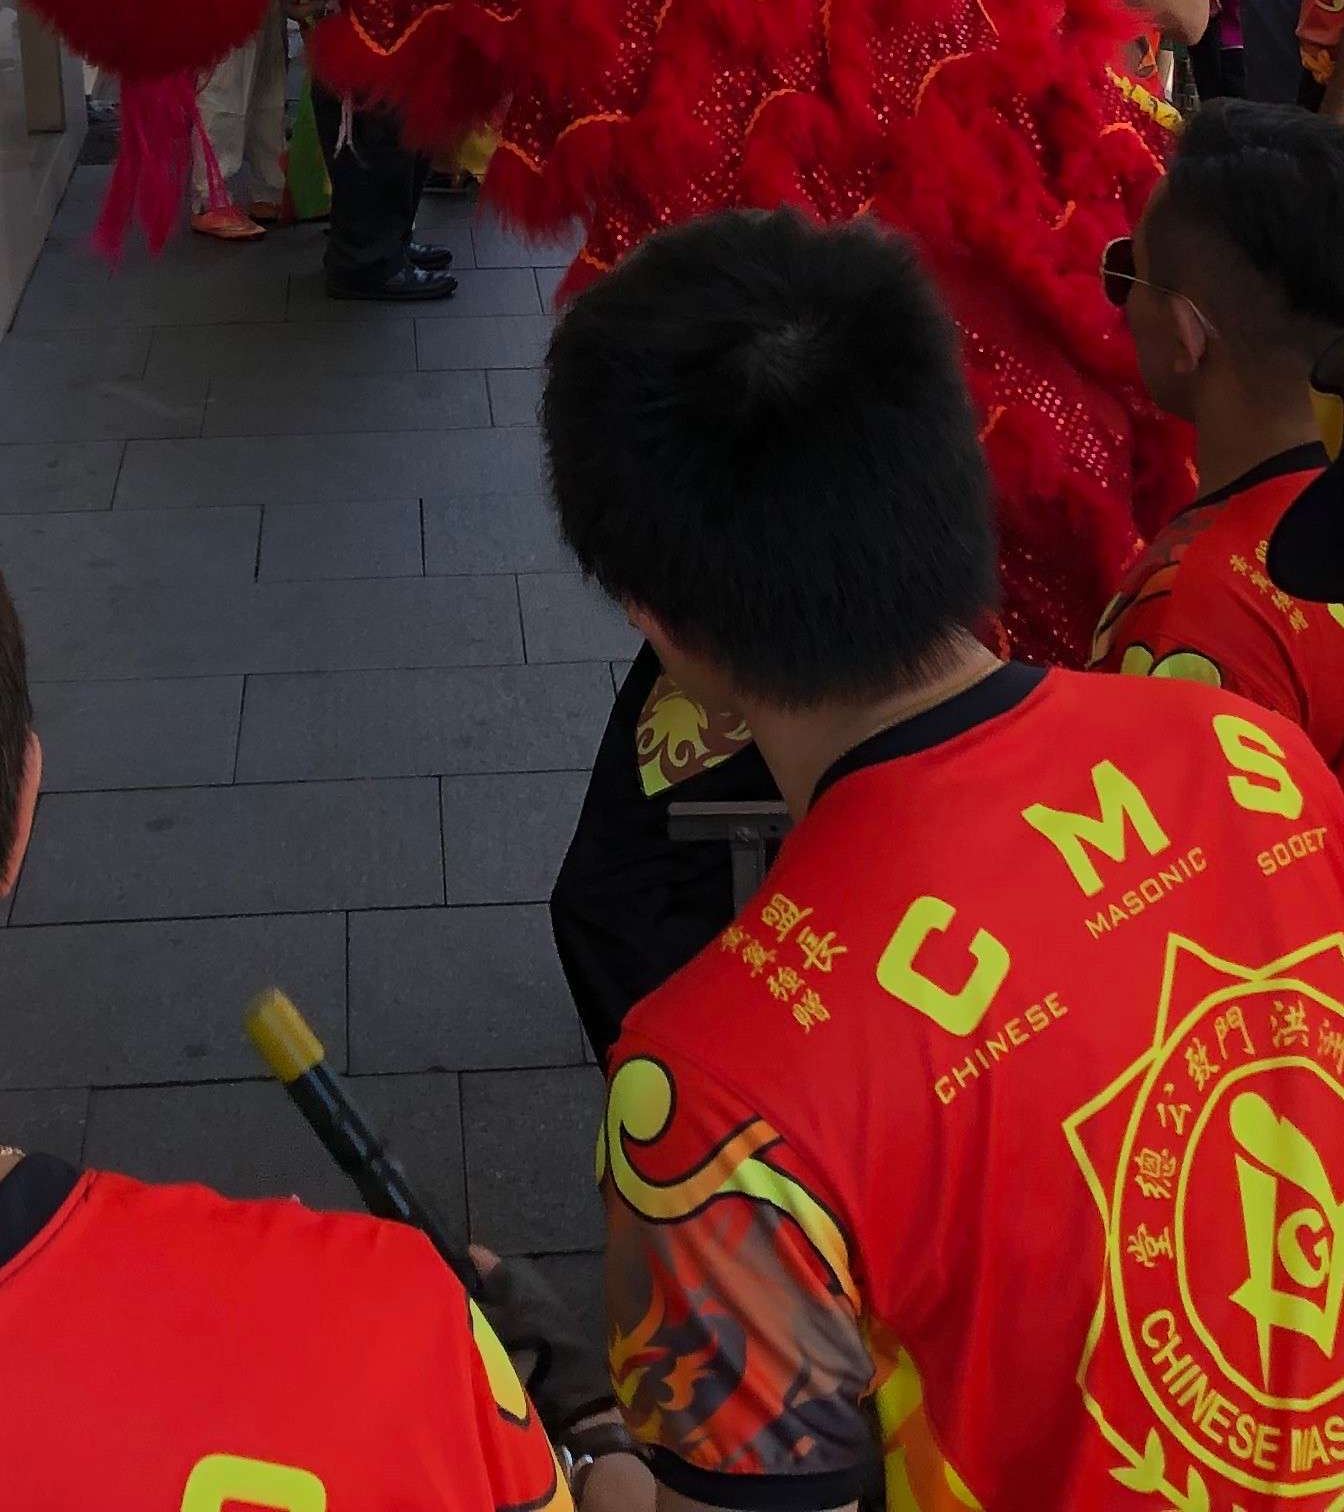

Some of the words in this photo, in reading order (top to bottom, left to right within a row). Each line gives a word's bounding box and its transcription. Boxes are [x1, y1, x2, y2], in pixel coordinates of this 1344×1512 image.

[877, 896, 1010, 1036] C
[1021, 760, 1170, 897] M
[1212, 714, 1304, 820] S
[933, 991, 1070, 1106] CHINESE
[1084, 846, 1208, 940] MASONIC
[1278, 1208, 1334, 1289] G
[1140, 1308, 1282, 1471] CHINESE
